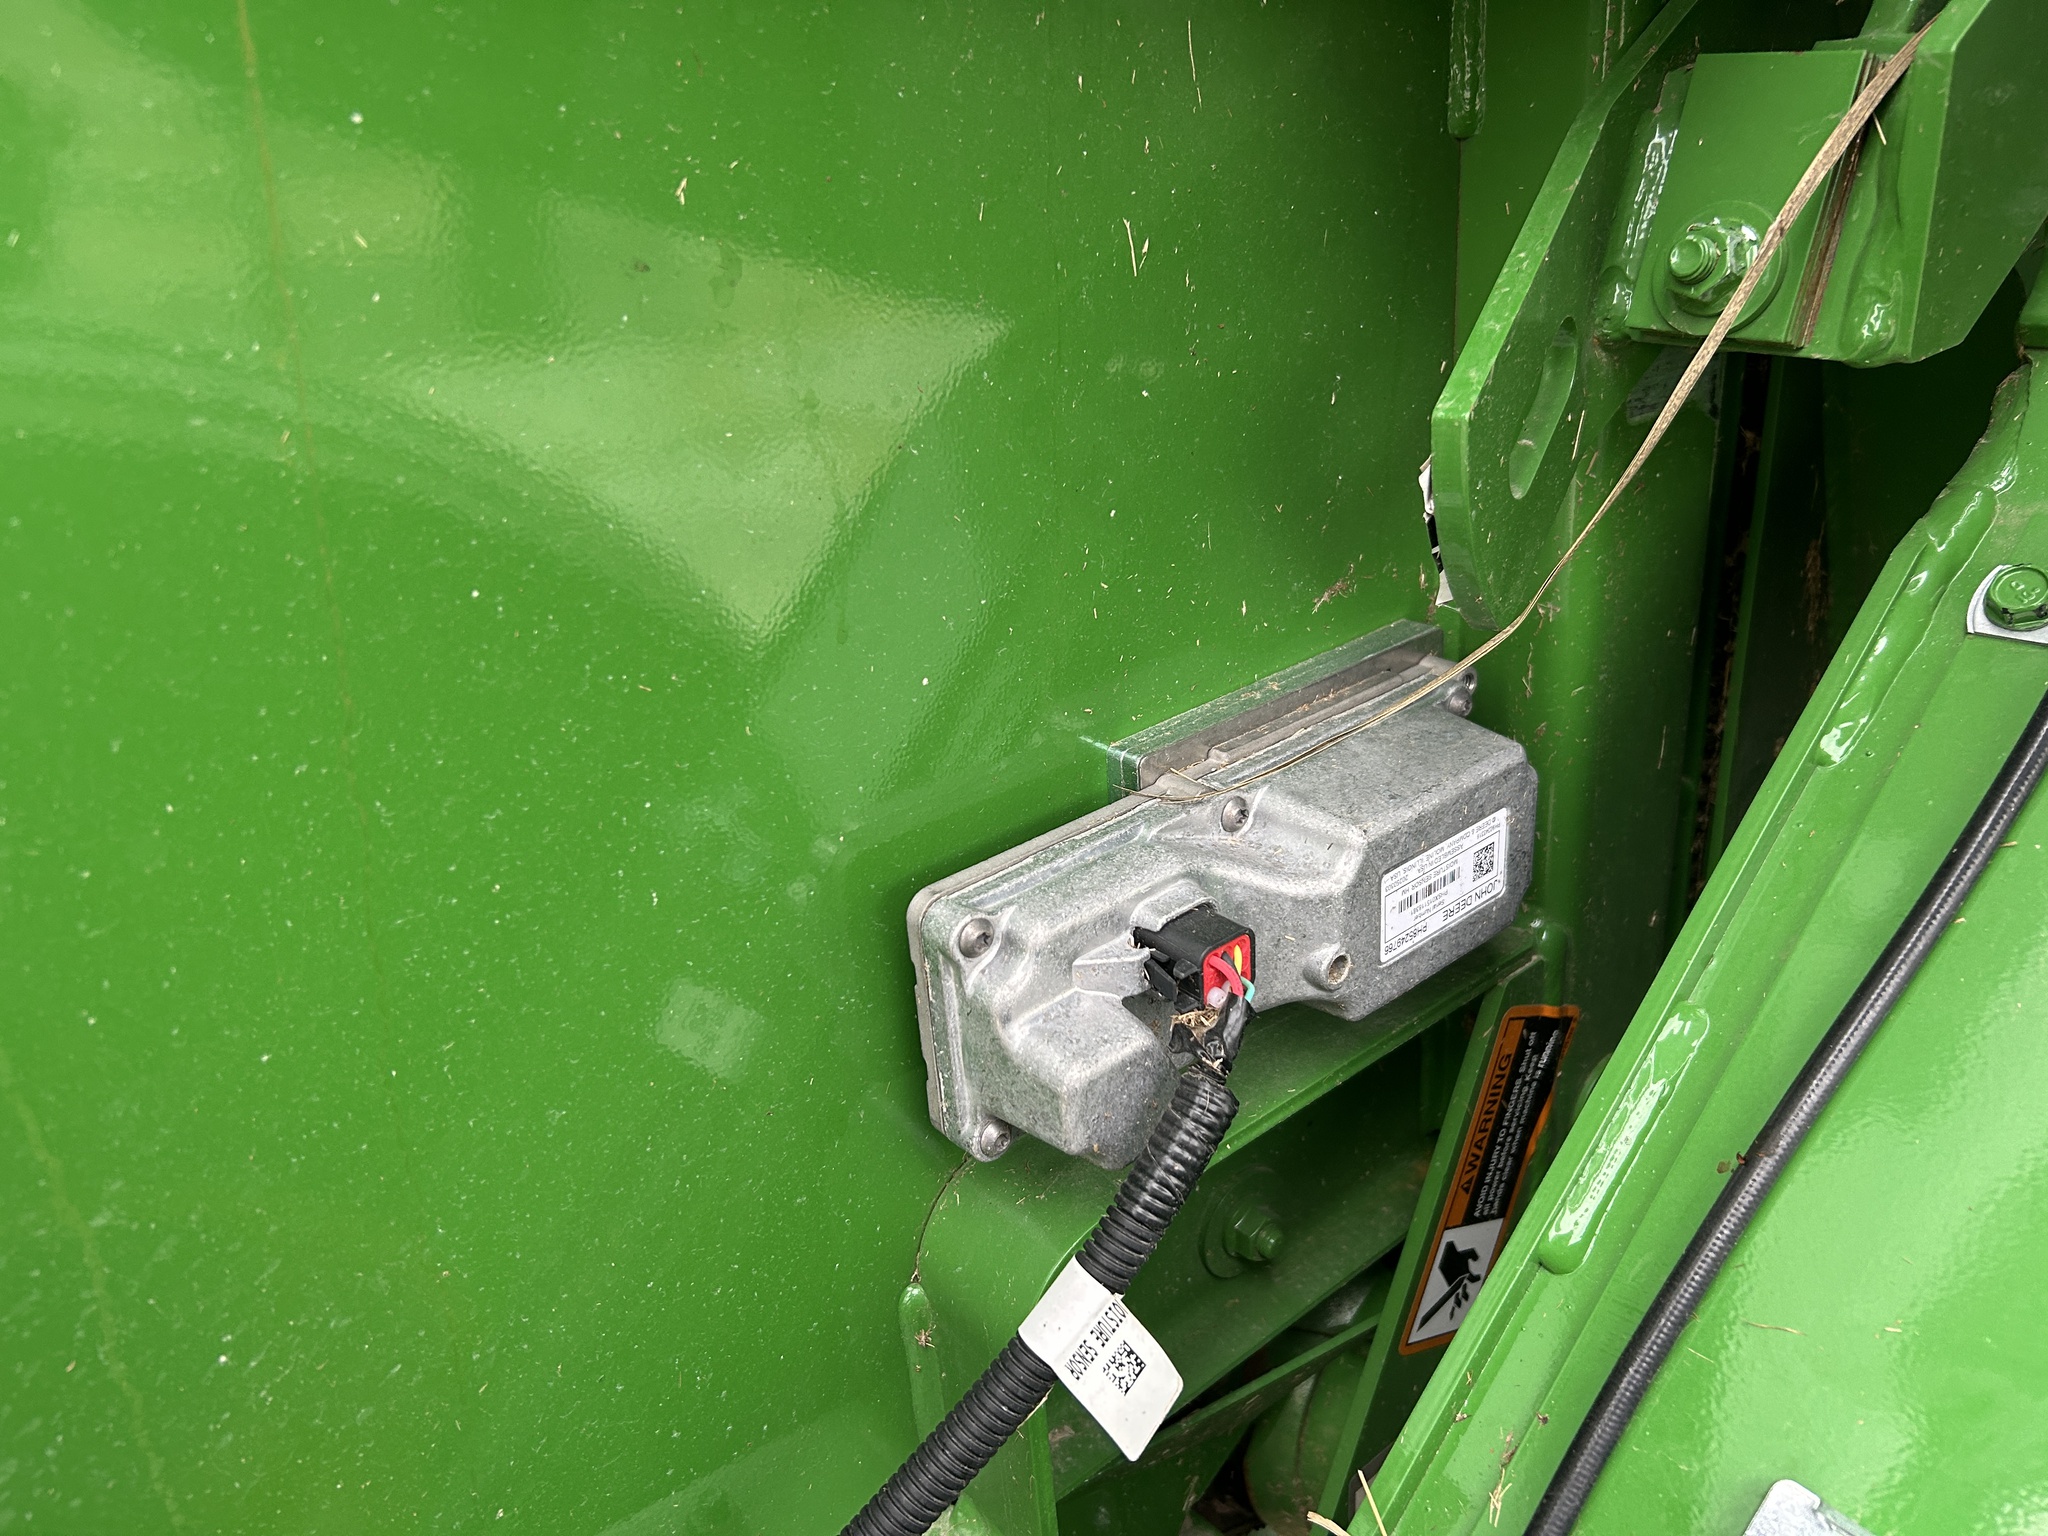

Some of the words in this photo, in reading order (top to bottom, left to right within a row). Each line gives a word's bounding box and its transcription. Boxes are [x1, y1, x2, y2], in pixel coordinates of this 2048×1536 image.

[1475, 818, 1491, 833] DEERE
[1429, 859, 1434, 868] IN
[1435, 842, 1463, 865] ASSEMBLED
[1391, 870, 1401, 882] USA
[1433, 858, 1458, 878] MOISTURE
[1411, 873, 1432, 891] SENSOR
[1475, 879, 1497, 903] JOHN
[1414, 907, 1431, 922] Number
[1432, 899, 1444, 911] Serial
[1443, 894, 1472, 922] DEERE
[1465, 1052, 1512, 1174] WARNING
[1472, 1184, 1489, 1217] AVOID
[1483, 1144, 1502, 1183] INJURY
[1496, 1128, 1506, 1143] TO
[1517, 1048, 1532, 1073] Shut
[1526, 1031, 1537, 1045] off
[1481, 1203, 1491, 1216] all
[1486, 1170, 1502, 1201] power
[1495, 1135, 1512, 1168] before
[1523, 1054, 1539, 1080] Keep
[1489, 1182, 1505, 1215] hands
[1500, 1156, 1513, 1180] clear
[1508, 1125, 1523, 1153] when
[1517, 1081, 1538, 1124] machine
[1532, 1069, 1542, 1078] is
[1090, 1301, 1129, 1348] OISTURE
[1064, 1339, 1099, 1381] SENSOR
